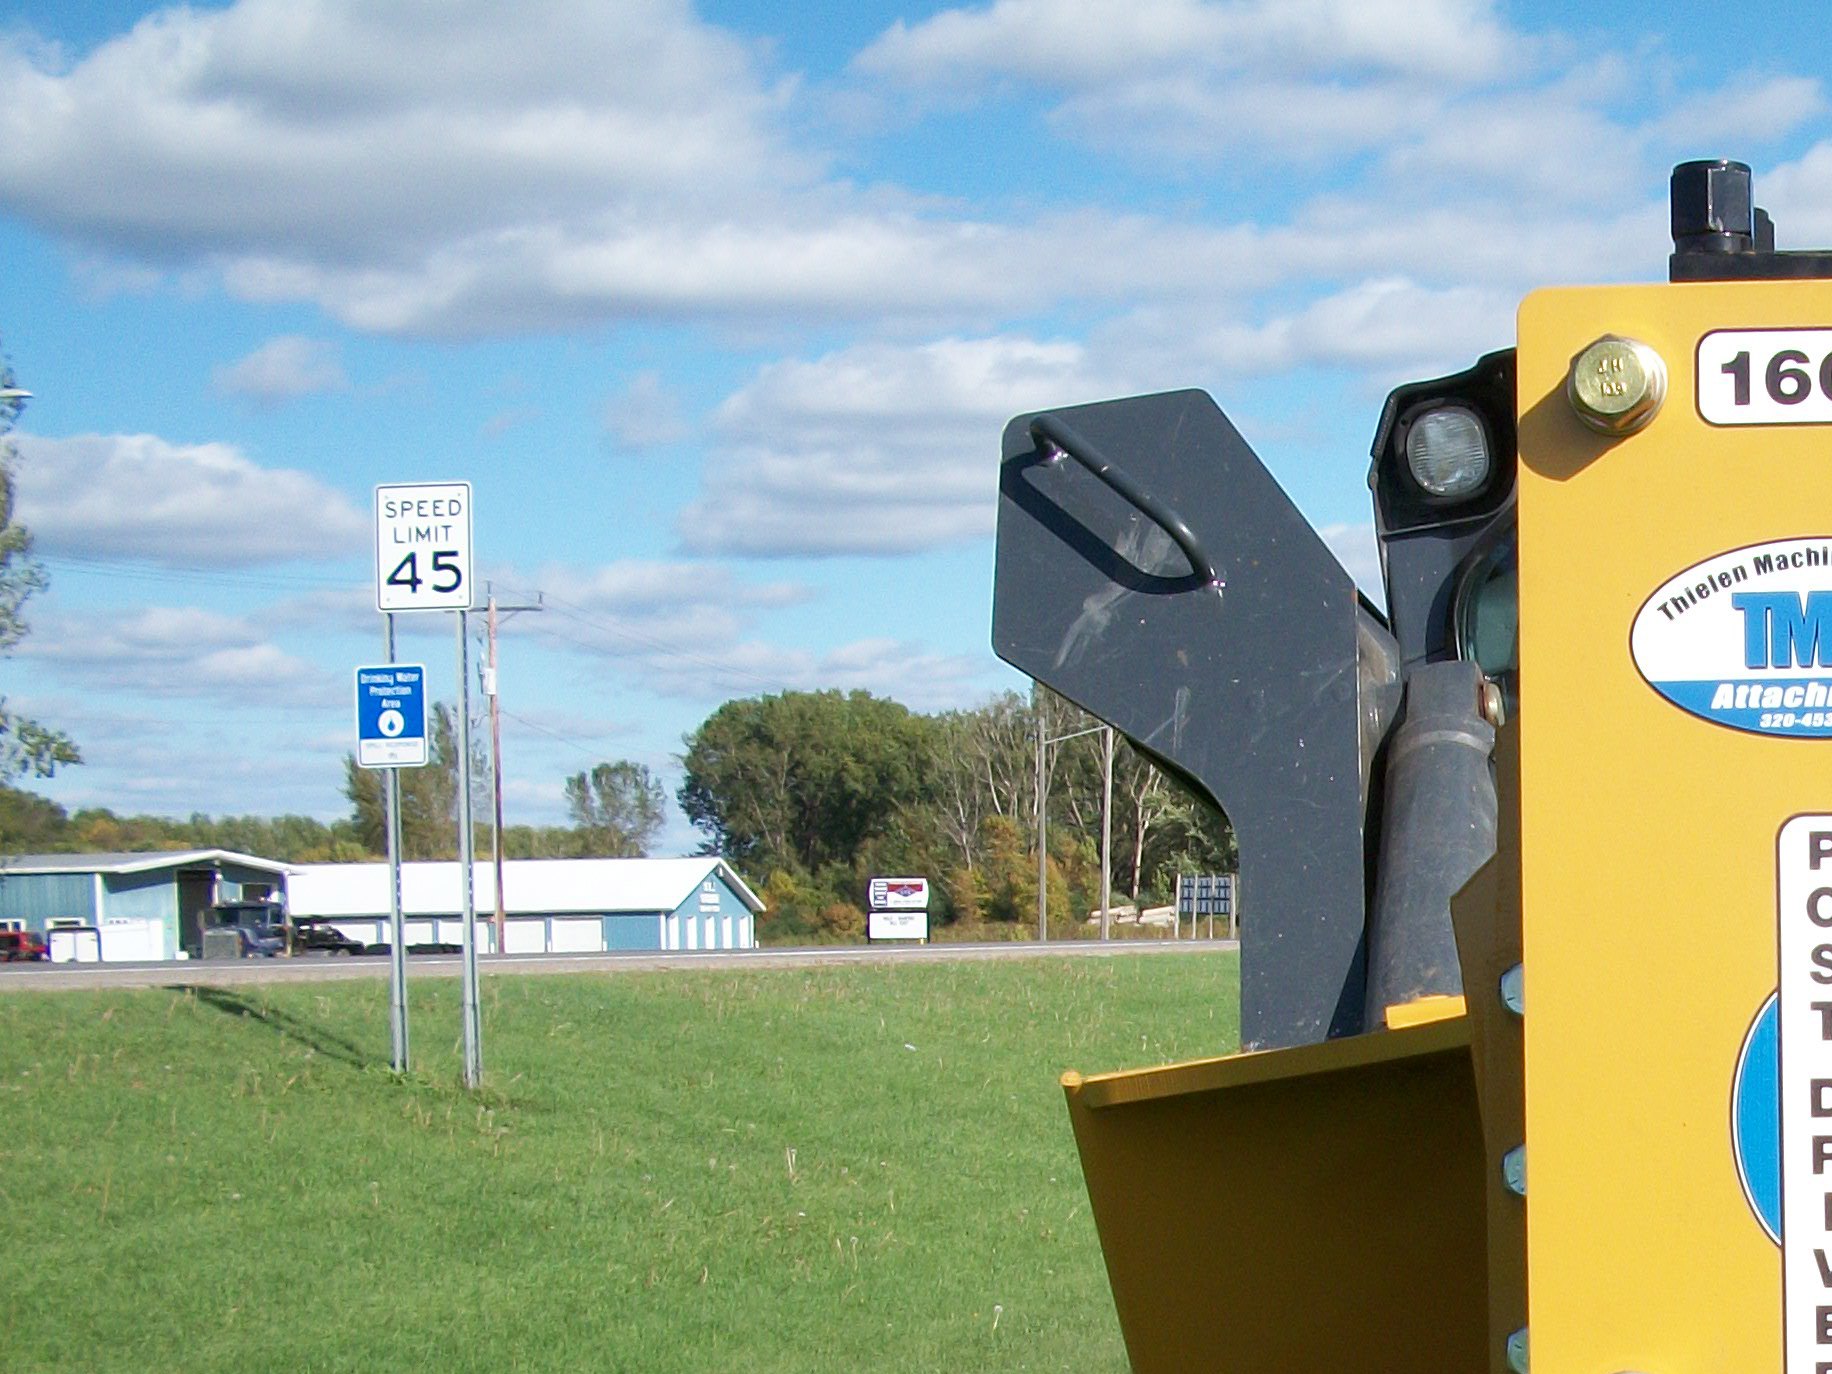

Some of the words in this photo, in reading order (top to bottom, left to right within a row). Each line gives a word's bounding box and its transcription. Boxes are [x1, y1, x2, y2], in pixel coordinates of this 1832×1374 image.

[385, 499, 463, 518] SPEED
[393, 525, 453, 544] LIMIT
[386, 550, 463, 594] 45
[1656, 565, 1748, 622] Thielen
